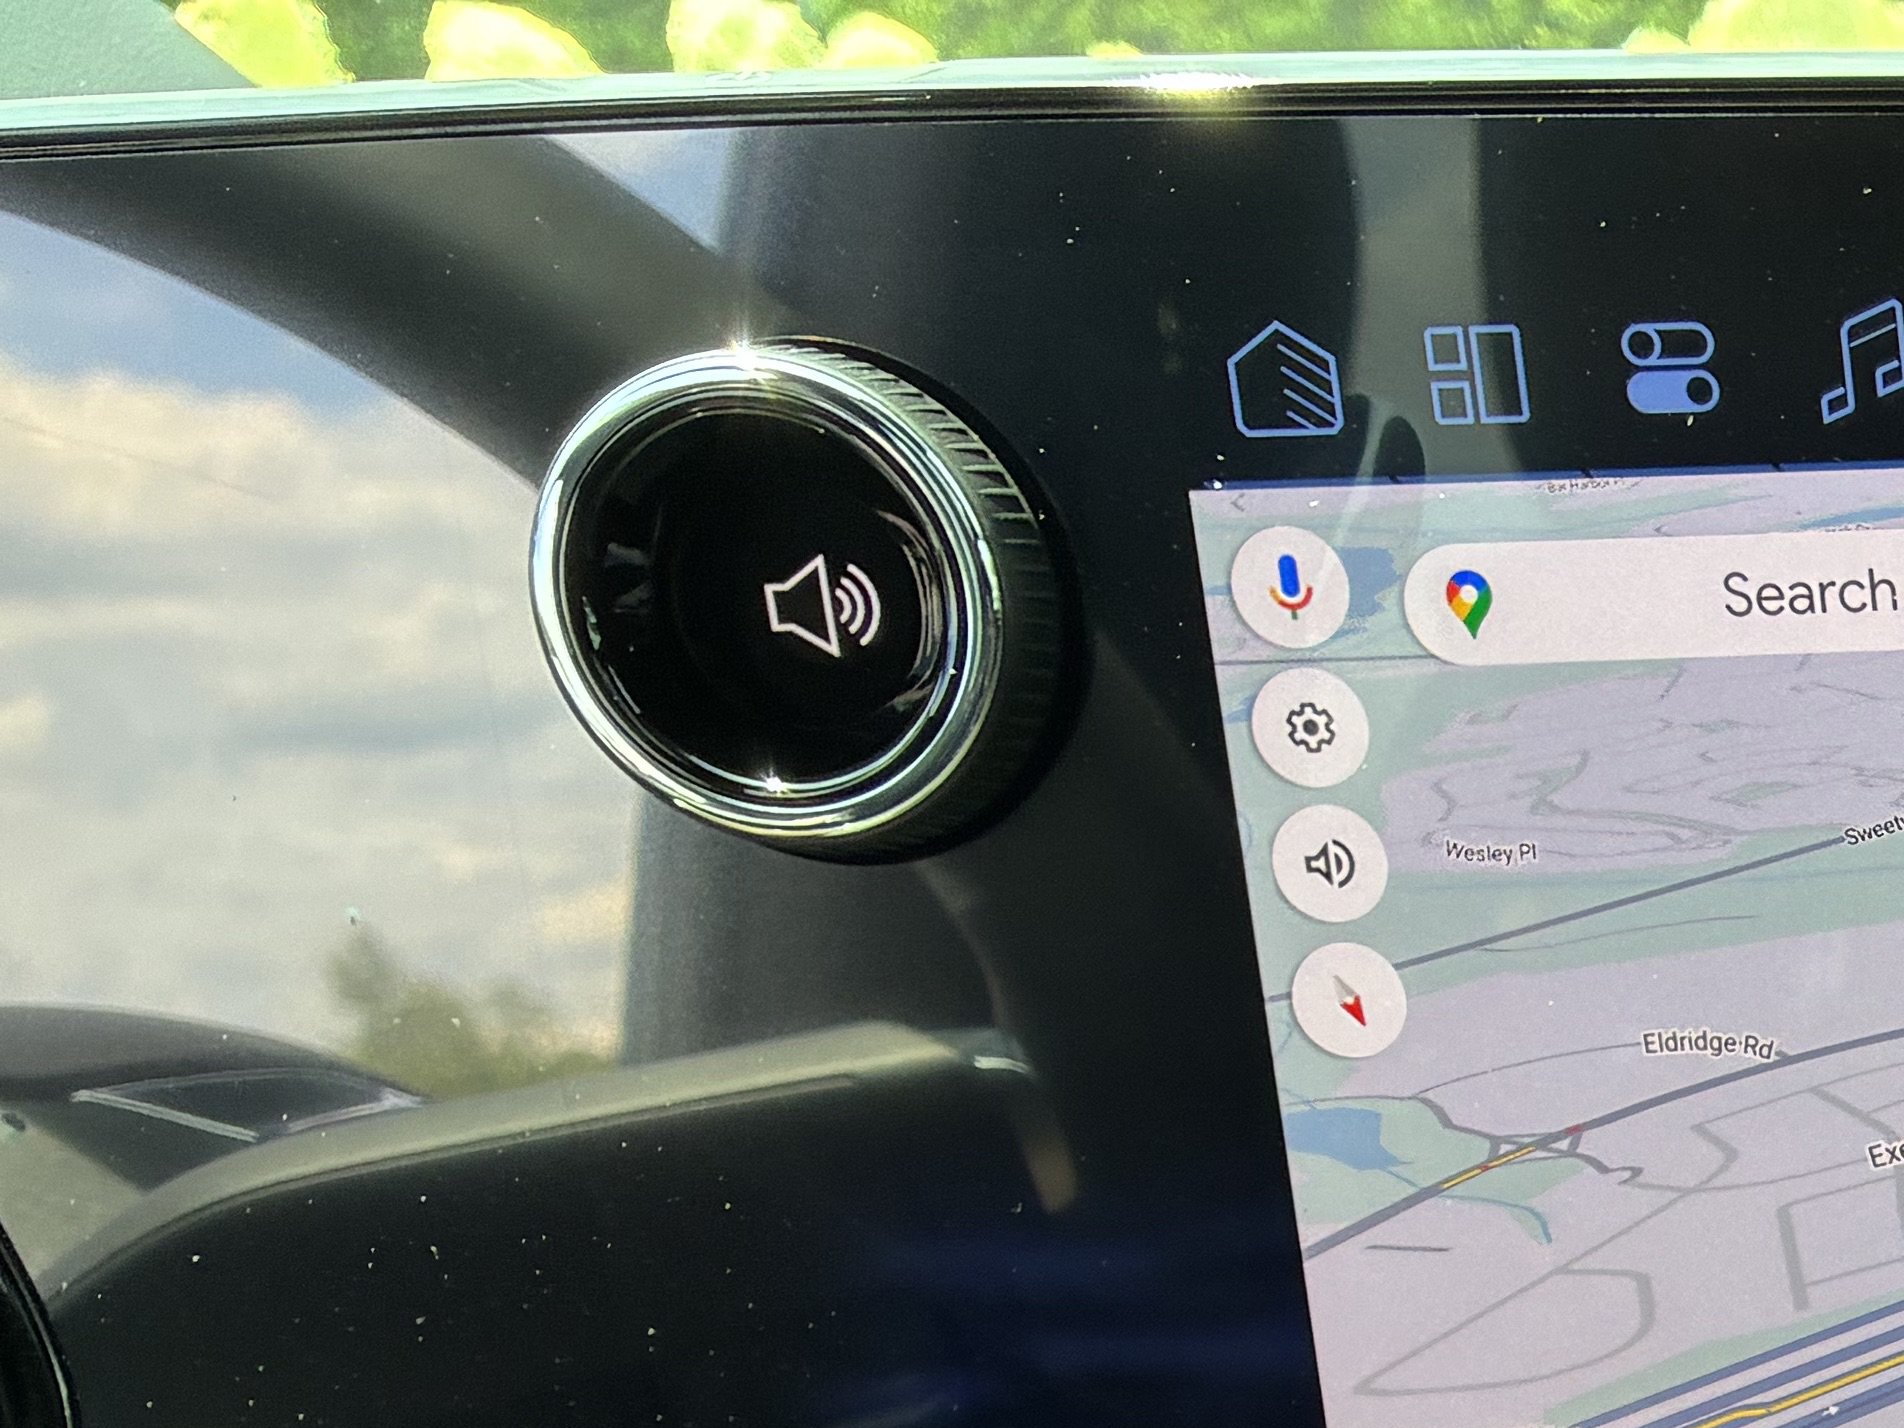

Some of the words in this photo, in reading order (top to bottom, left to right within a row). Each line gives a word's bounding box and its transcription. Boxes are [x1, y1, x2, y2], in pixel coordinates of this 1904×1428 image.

[1724, 567, 1898, 619] Search
[1446, 839, 1513, 866] Wesley
[1517, 843, 1537, 860] Pl
[1643, 1030, 1737, 1056] Eldridge
[1743, 1036, 1775, 1059] Rd
